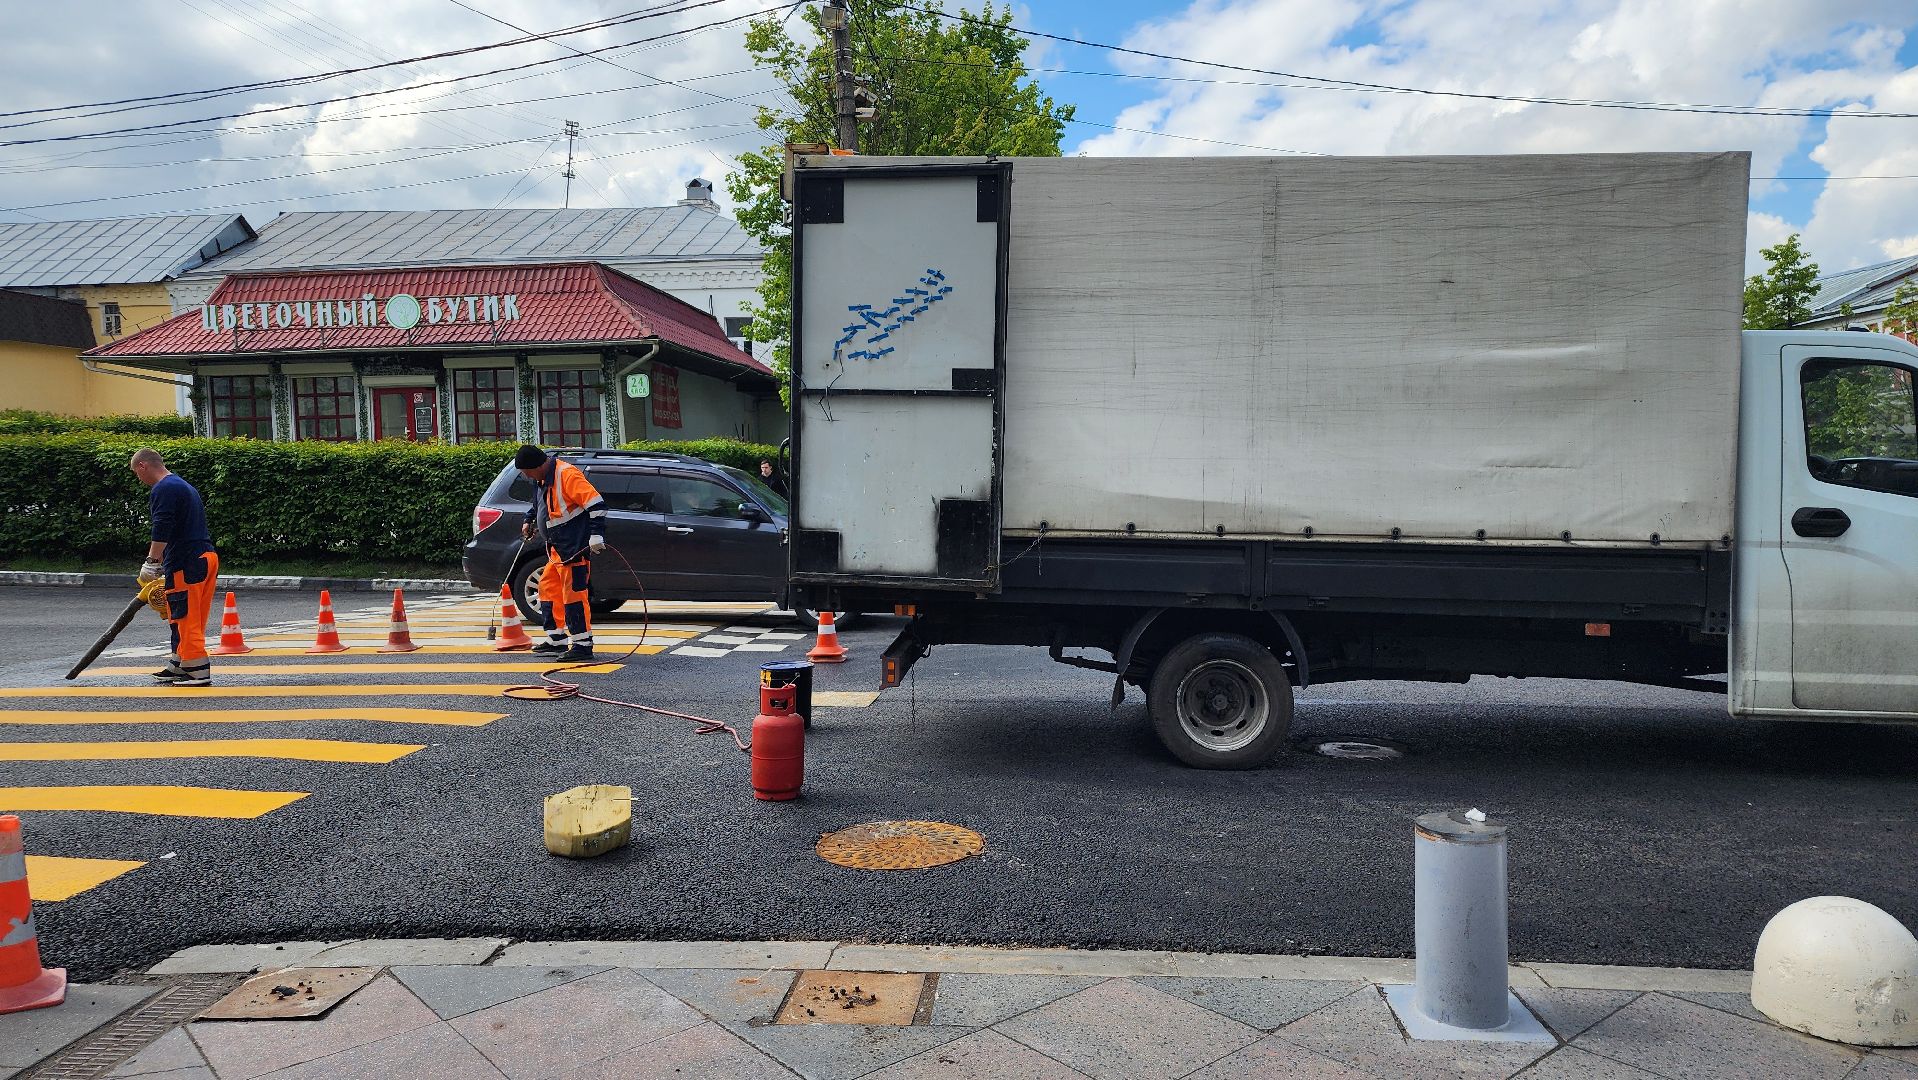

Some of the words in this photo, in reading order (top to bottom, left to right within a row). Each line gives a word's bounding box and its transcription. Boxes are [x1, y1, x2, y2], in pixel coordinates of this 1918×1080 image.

[201, 294, 378, 333] ЦВЕТОЧНЫЙ
[428, 295, 520, 324] БУТИК
[631, 377, 643, 388] 24
